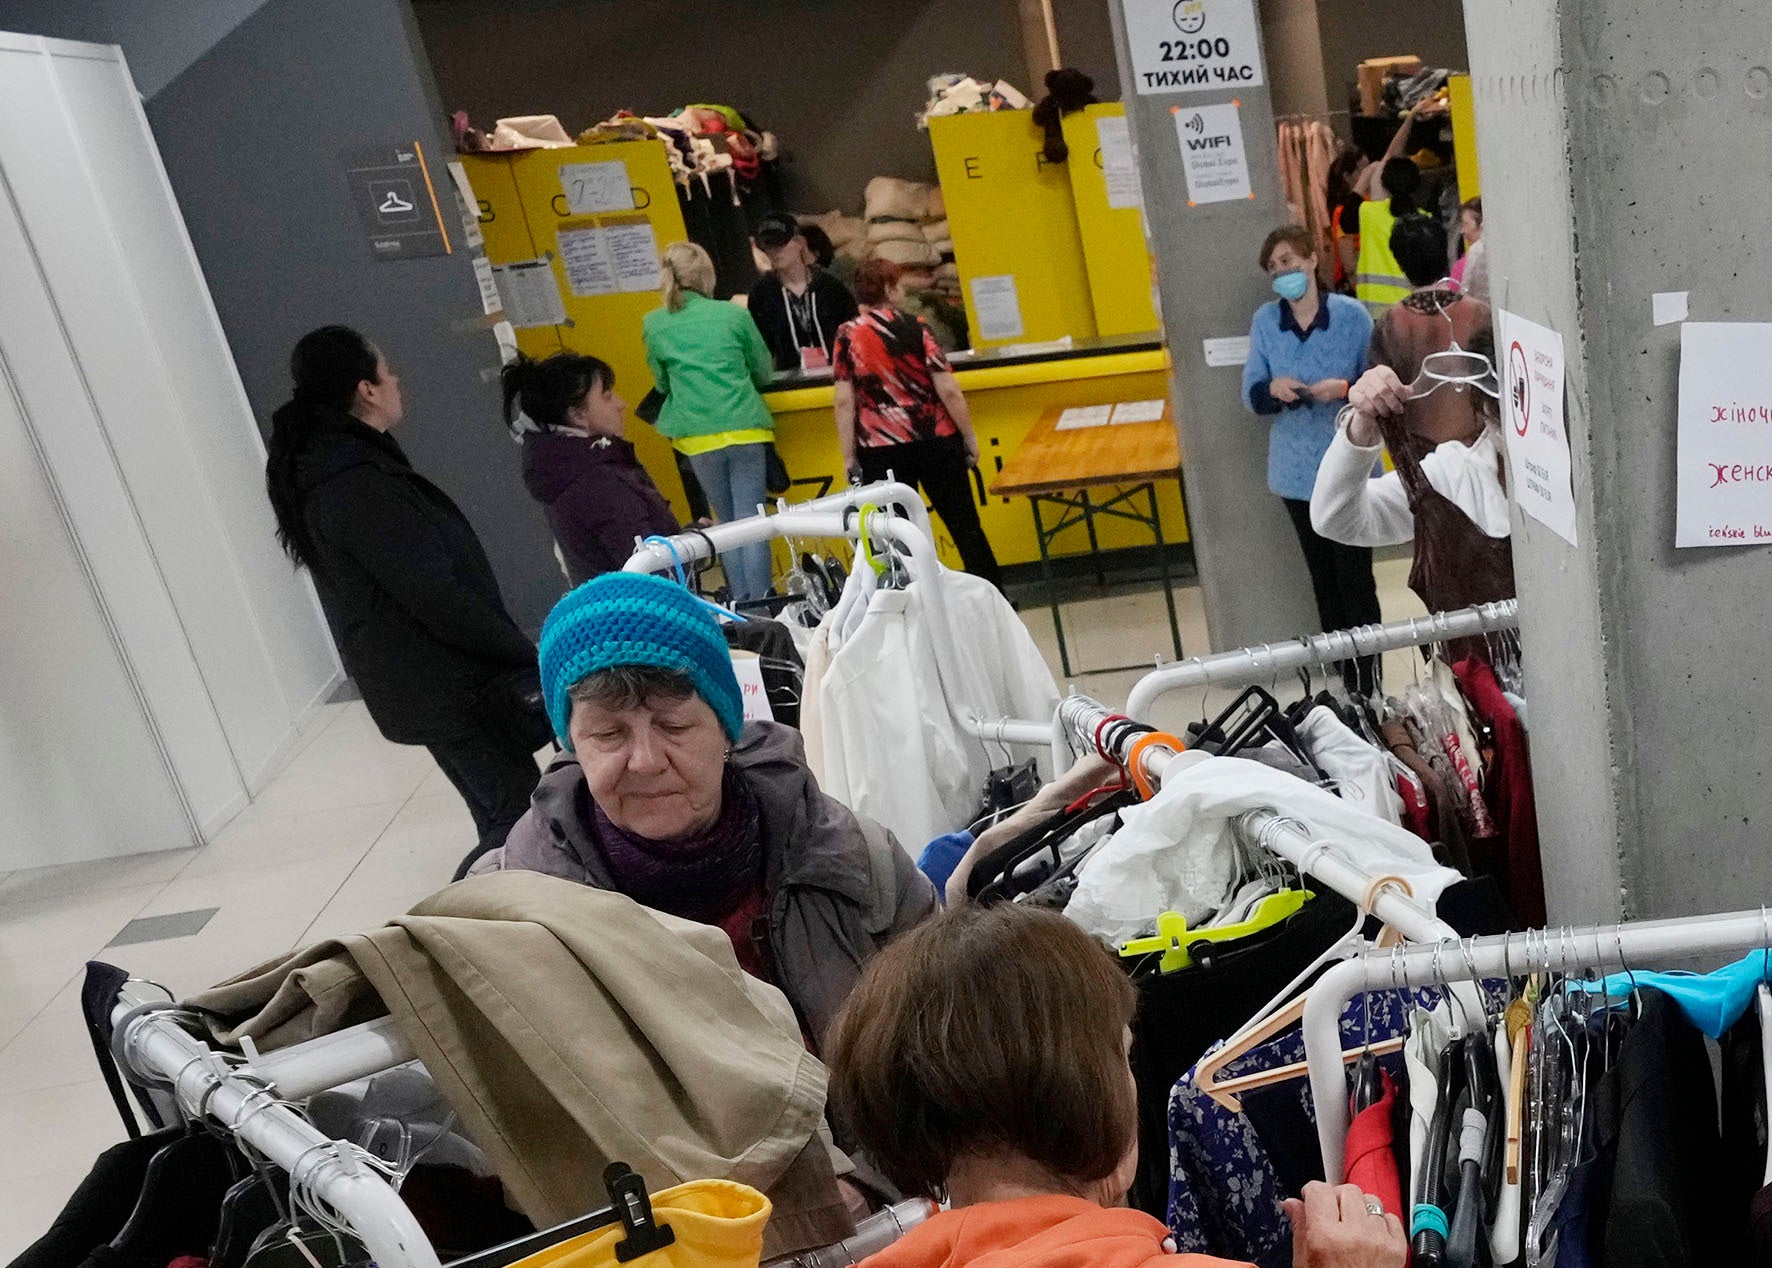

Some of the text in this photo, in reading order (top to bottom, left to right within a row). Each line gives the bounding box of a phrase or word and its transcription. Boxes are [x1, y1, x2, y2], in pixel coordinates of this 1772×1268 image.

[1159, 38, 1230, 62] 22:00
[1143, 65, 1254, 88] ТИХИЙ ЧАС
[1187, 135, 1231, 151] WIFI
[964, 157, 983, 180] E
